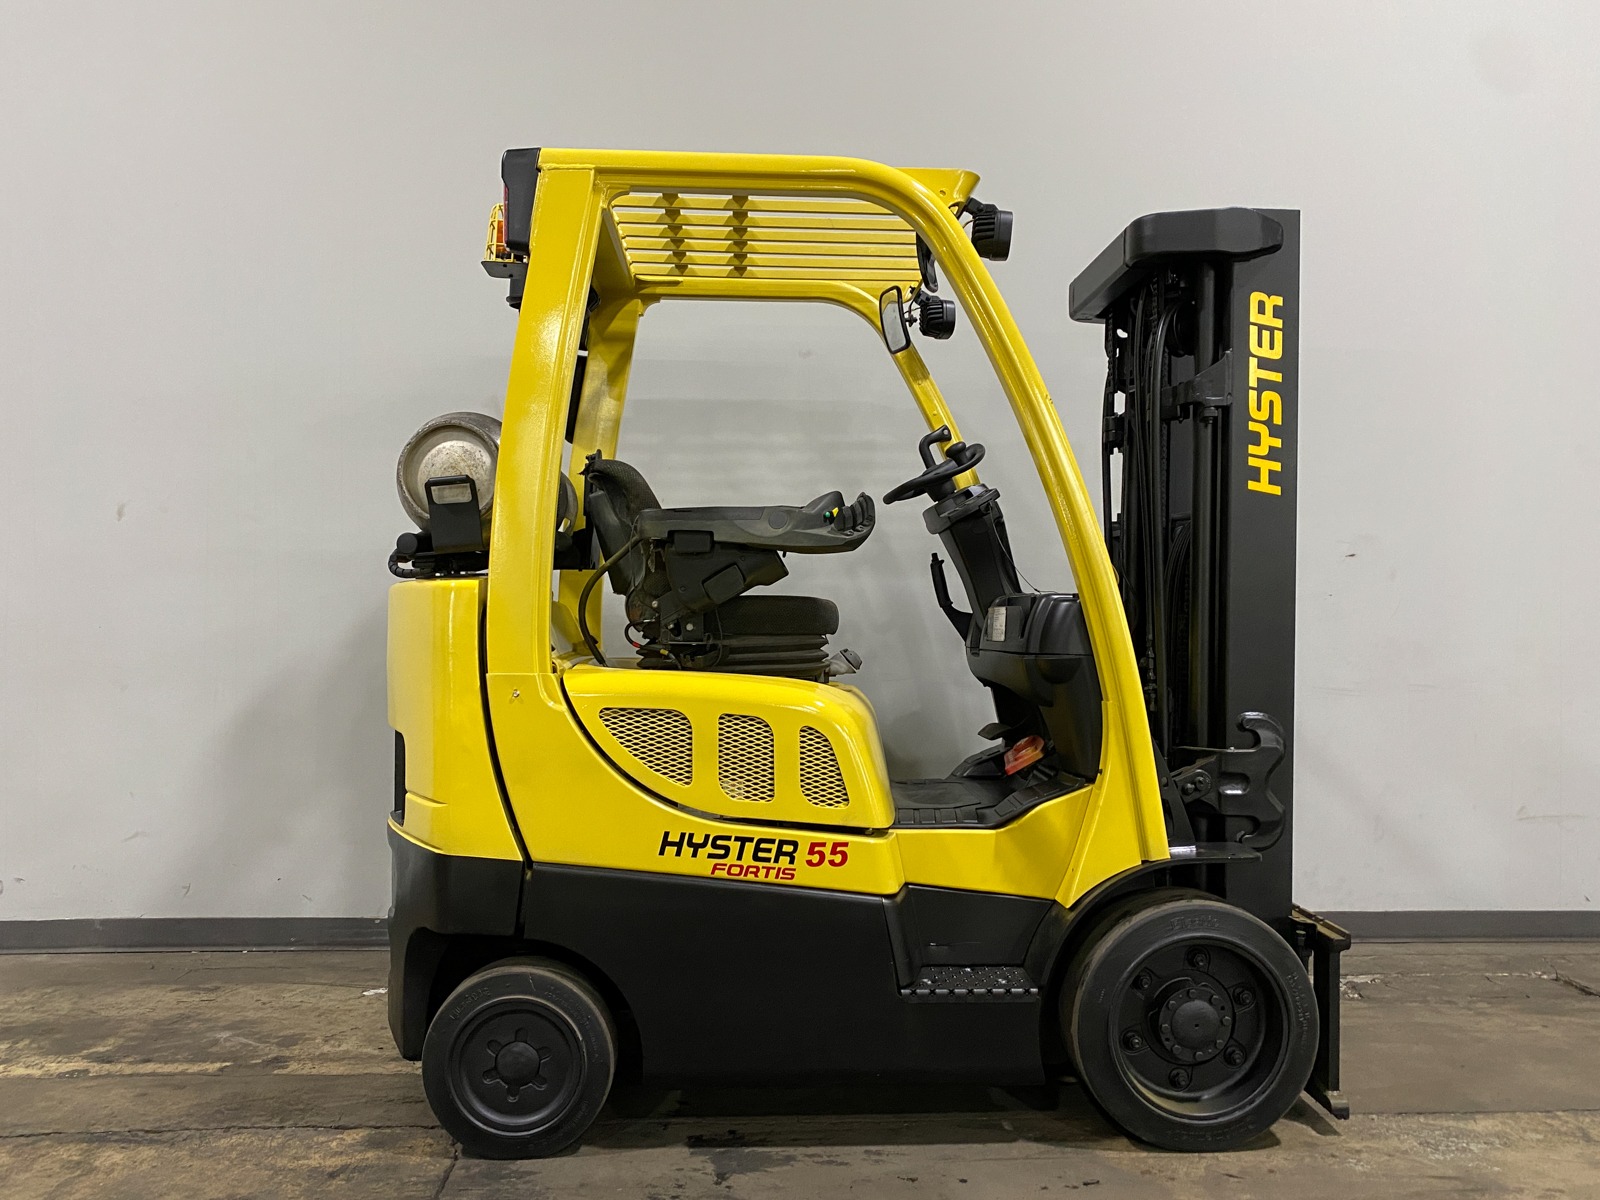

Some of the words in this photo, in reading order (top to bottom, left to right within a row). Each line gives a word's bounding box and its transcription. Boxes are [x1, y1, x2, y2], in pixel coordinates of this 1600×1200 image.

[1247, 291, 1284, 496] HYSTER
[658, 831, 799, 865] HYSTER
[805, 841, 849, 868] 55
[710, 862, 797, 880] FORTIS
